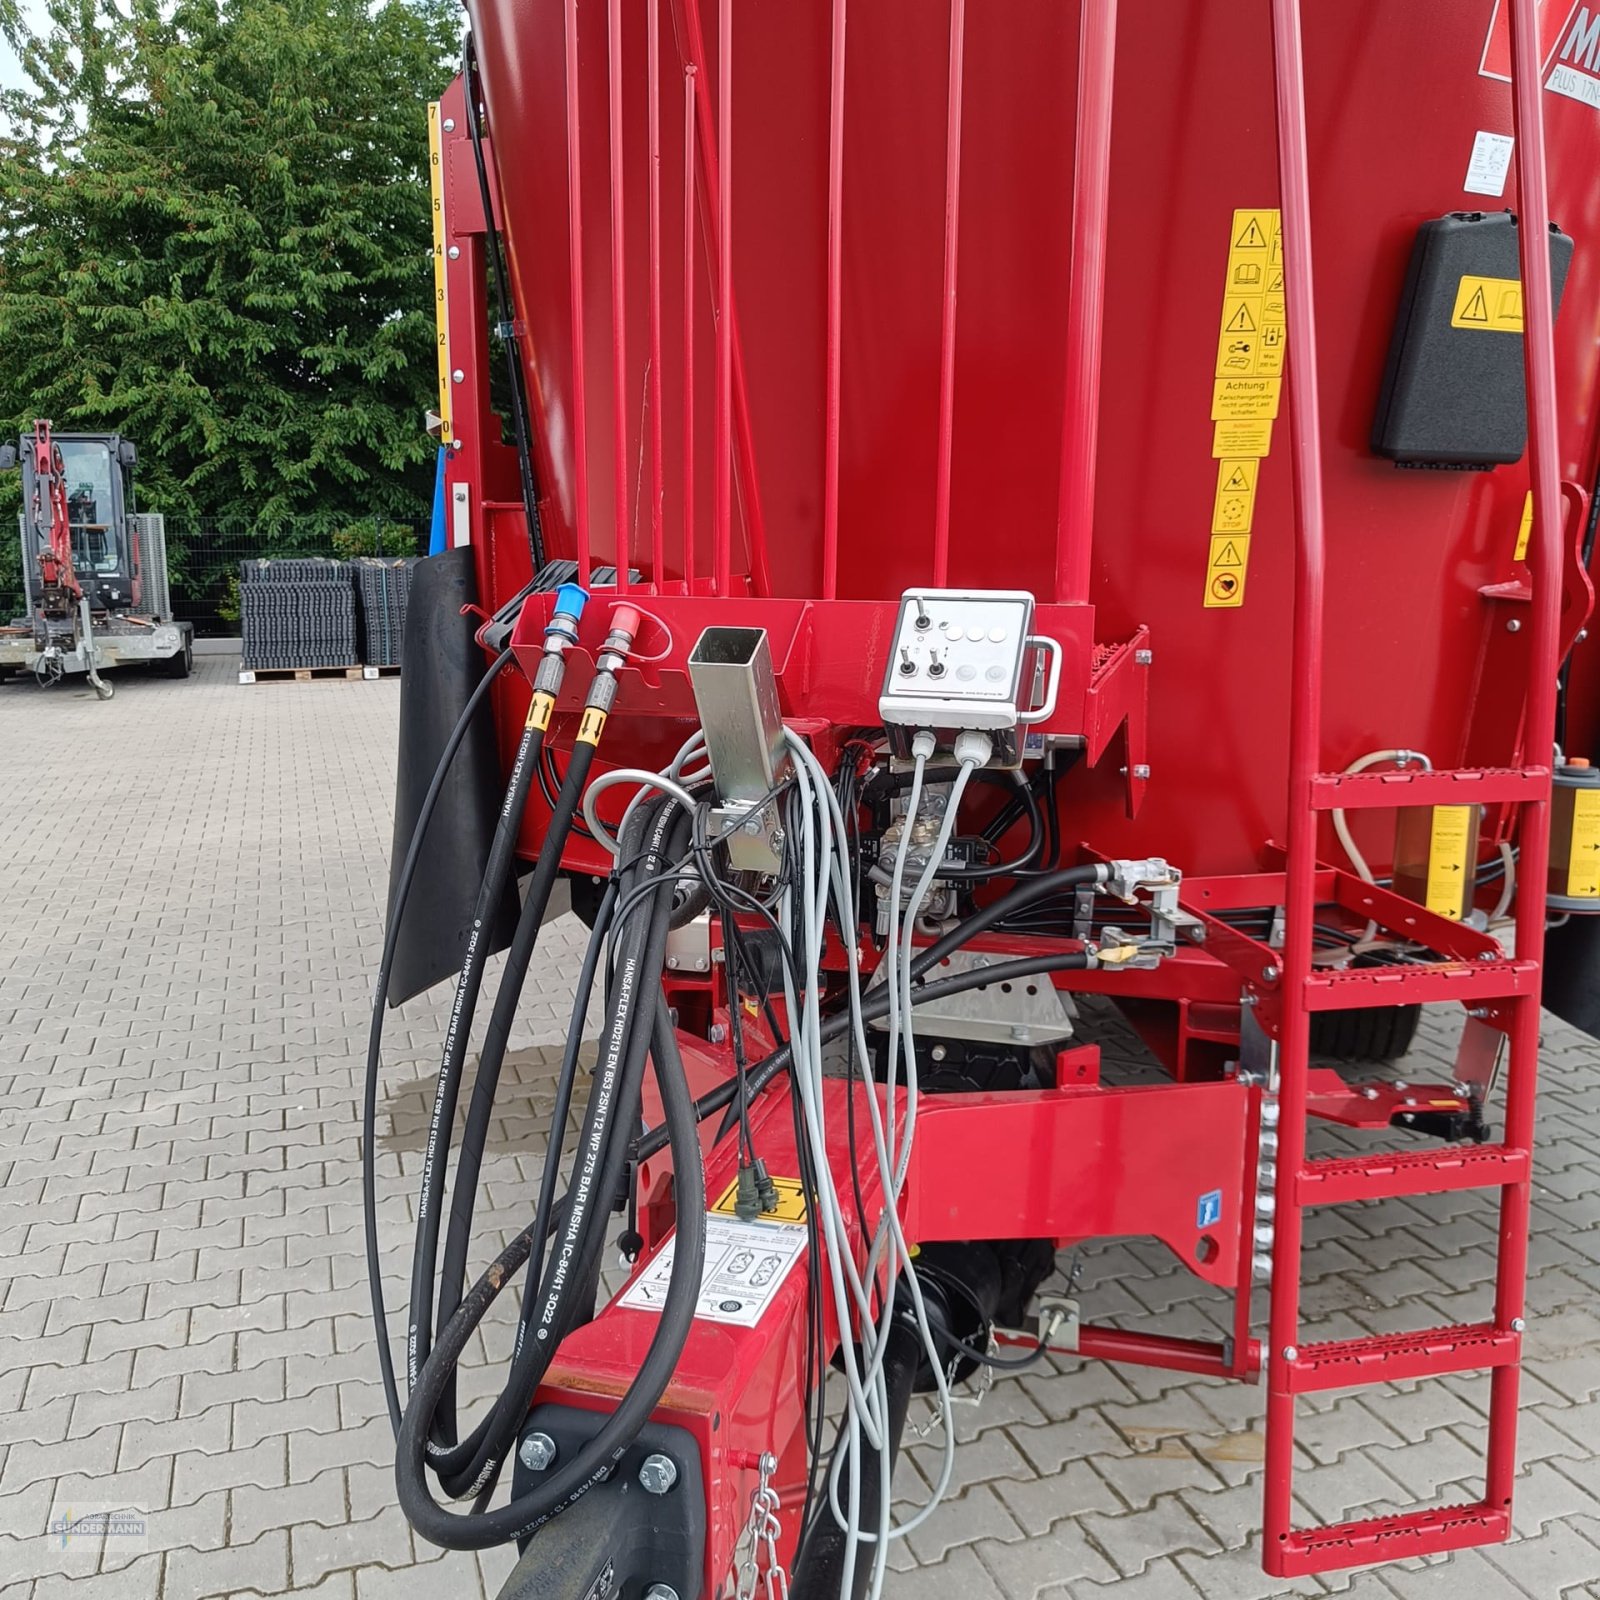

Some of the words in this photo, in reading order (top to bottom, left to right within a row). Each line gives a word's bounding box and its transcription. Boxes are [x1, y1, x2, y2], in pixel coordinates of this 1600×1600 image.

[1552, 69, 1576, 92] PLUS
[430, 106, 436, 119] 7
[432, 152, 438, 166] 6
[434, 198, 440, 211] 5
[436, 244, 442, 256] 4
[438, 288, 444, 301] 3
[439, 333, 445, 345] 2
[441, 377, 446, 389] 1
[1226, 381, 1269, 391] Achtung!
[443, 421, 449, 433] 0
[502, 760, 524, 817] HANSA-FLEX
[518, 733, 531, 760] HD213
[468, 930, 479, 953] 3Q22
[461, 954, 473, 988] IC-84/41
[614, 958, 636, 1021] HANSA-FLEX
[454, 988, 466, 1014] MSHA
[449, 1014, 459, 1035] BAR
[446, 1035, 455, 1052] 275
[610, 1020, 624, 1052] HD213
[443, 1052, 451, 1067] WP
[606, 1053, 618, 1069] EN
[441, 1067, 449, 1079] 12
[602, 1070, 614, 1089] 853
[437, 1079, 446, 1099] 2SN
[434, 1099, 443, 1115] 853
[596, 1091, 610, 1114] 2SN
[431, 1117, 440, 1132] EN
[593, 1115, 605, 1129] 12
[427, 1130, 437, 1159] HD213
[589, 1132, 603, 1151] WP
[583, 1152, 598, 1174] 275
[420, 1160, 433, 1218] HANSA-FLEX
[577, 1175, 592, 1203] BAR
[566, 1204, 585, 1241] MSHA
[551, 1243, 574, 1291] IC-84/41
[541, 1292, 560, 1325] 3Q22
[592, 1466, 607, 1481] DIN
[569, 1479, 596, 1501] 74310
